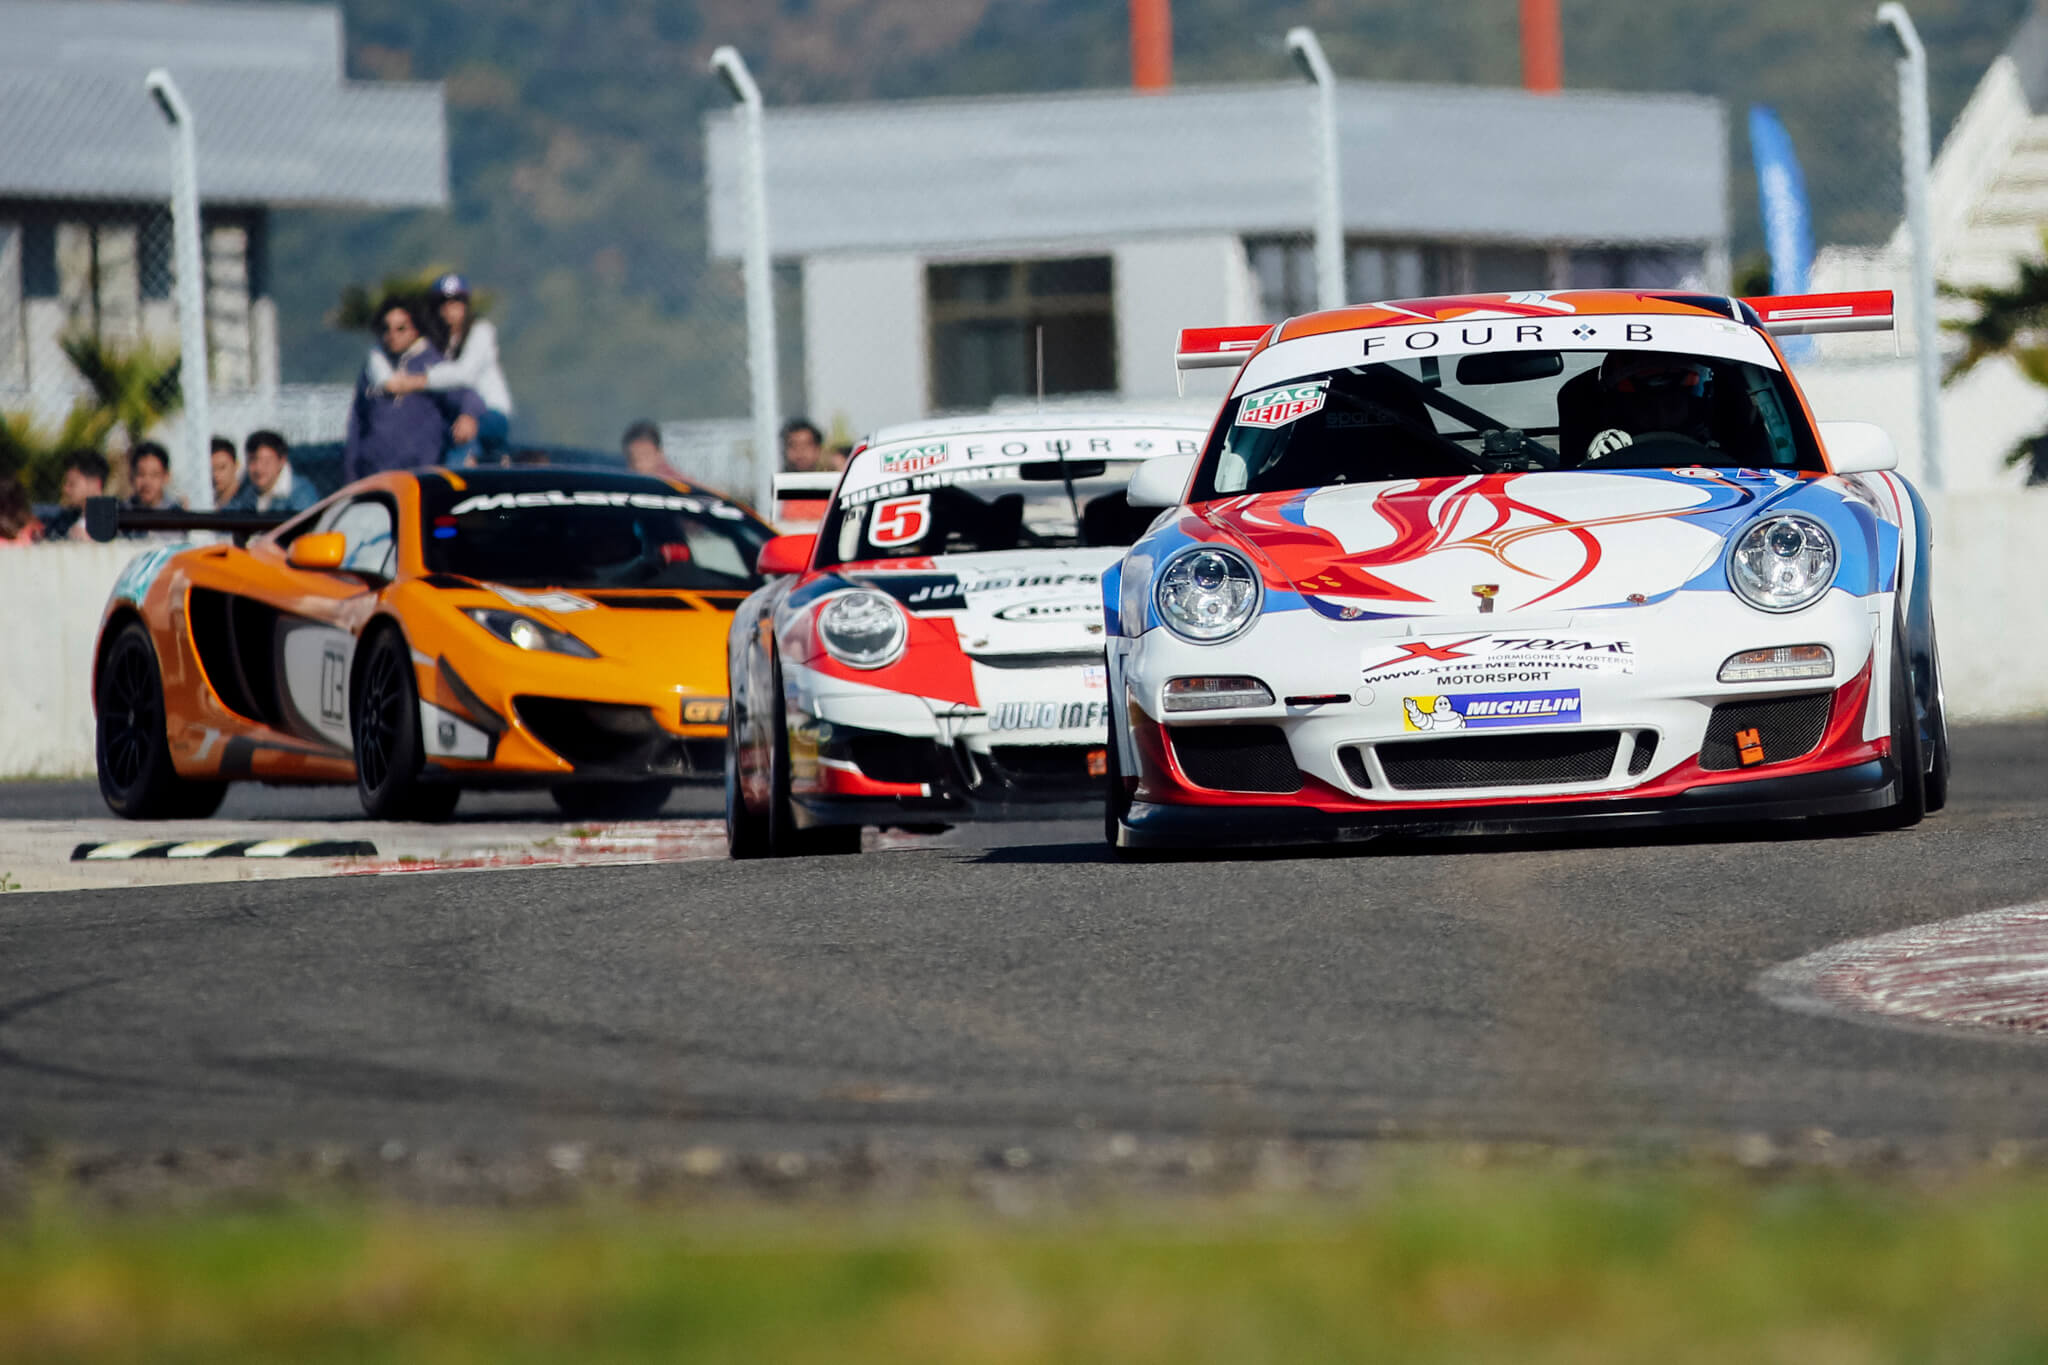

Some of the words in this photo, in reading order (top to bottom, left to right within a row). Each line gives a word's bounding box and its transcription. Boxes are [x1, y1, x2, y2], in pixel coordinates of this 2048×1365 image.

[1363, 324, 1543, 356] FOUR
[1625, 324, 1654, 343] B
[1251, 386, 1318, 407] TAG
[1243, 399, 1319, 424] HEUER
[966, 439, 1113, 461] FOUR
[872, 498, 924, 545] 5
[1487, 654, 1561, 662] HORMIGONES
[1437, 671, 1551, 686] MOTORSPORT
[988, 702, 1057, 731] JULIO
[1465, 697, 1579, 717] MICHELIN
